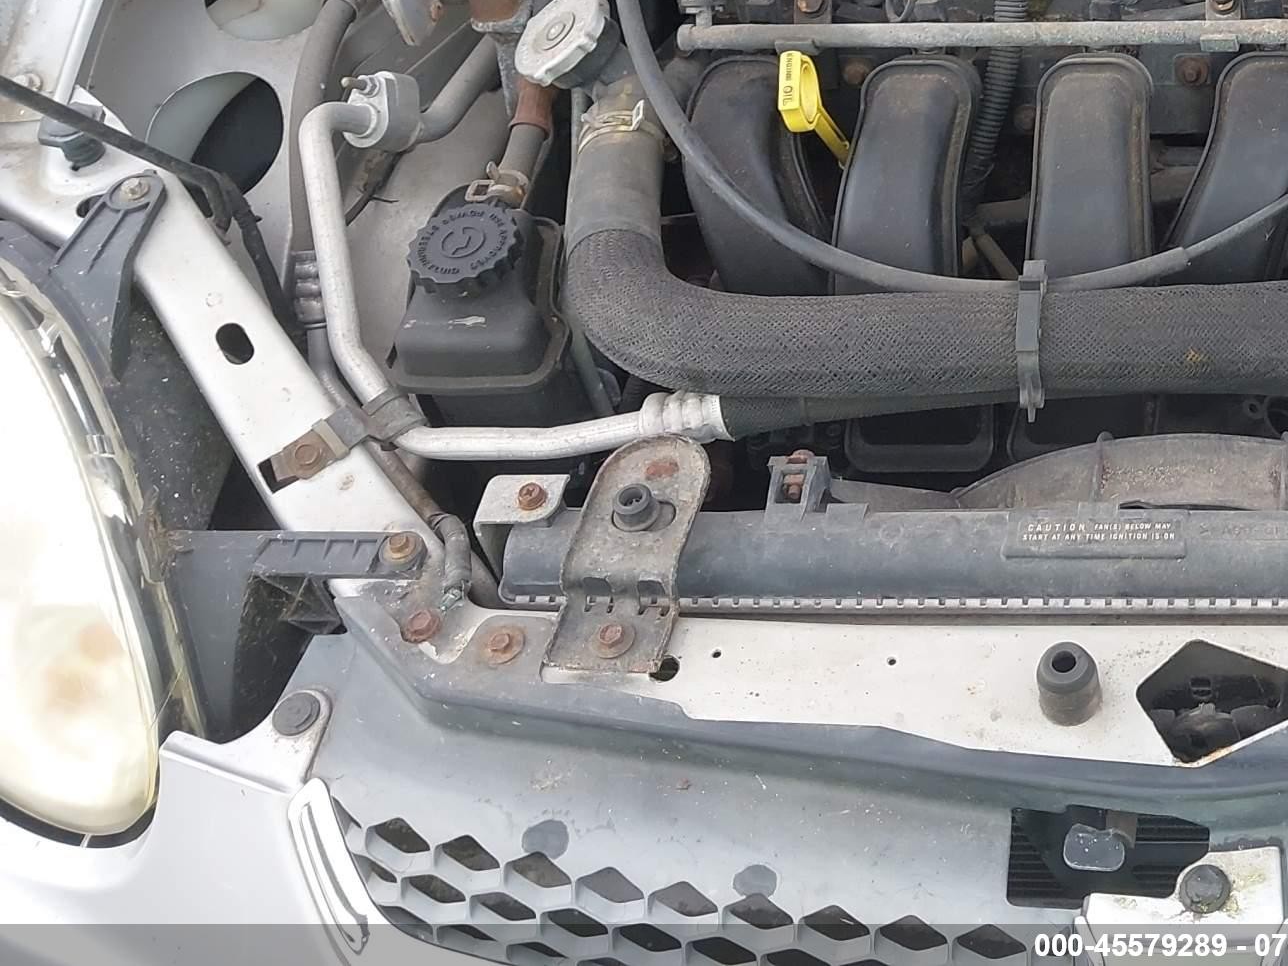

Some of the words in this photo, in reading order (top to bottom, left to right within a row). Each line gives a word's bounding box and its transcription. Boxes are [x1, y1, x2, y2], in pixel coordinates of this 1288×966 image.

[782, 85, 793, 107] OIL
[1027, 523, 1086, 532] CAUTION
[1125, 522, 1151, 530] BELOW
[1154, 522, 1171, 530] MAY
[1086, 533, 1105, 541] TIME
